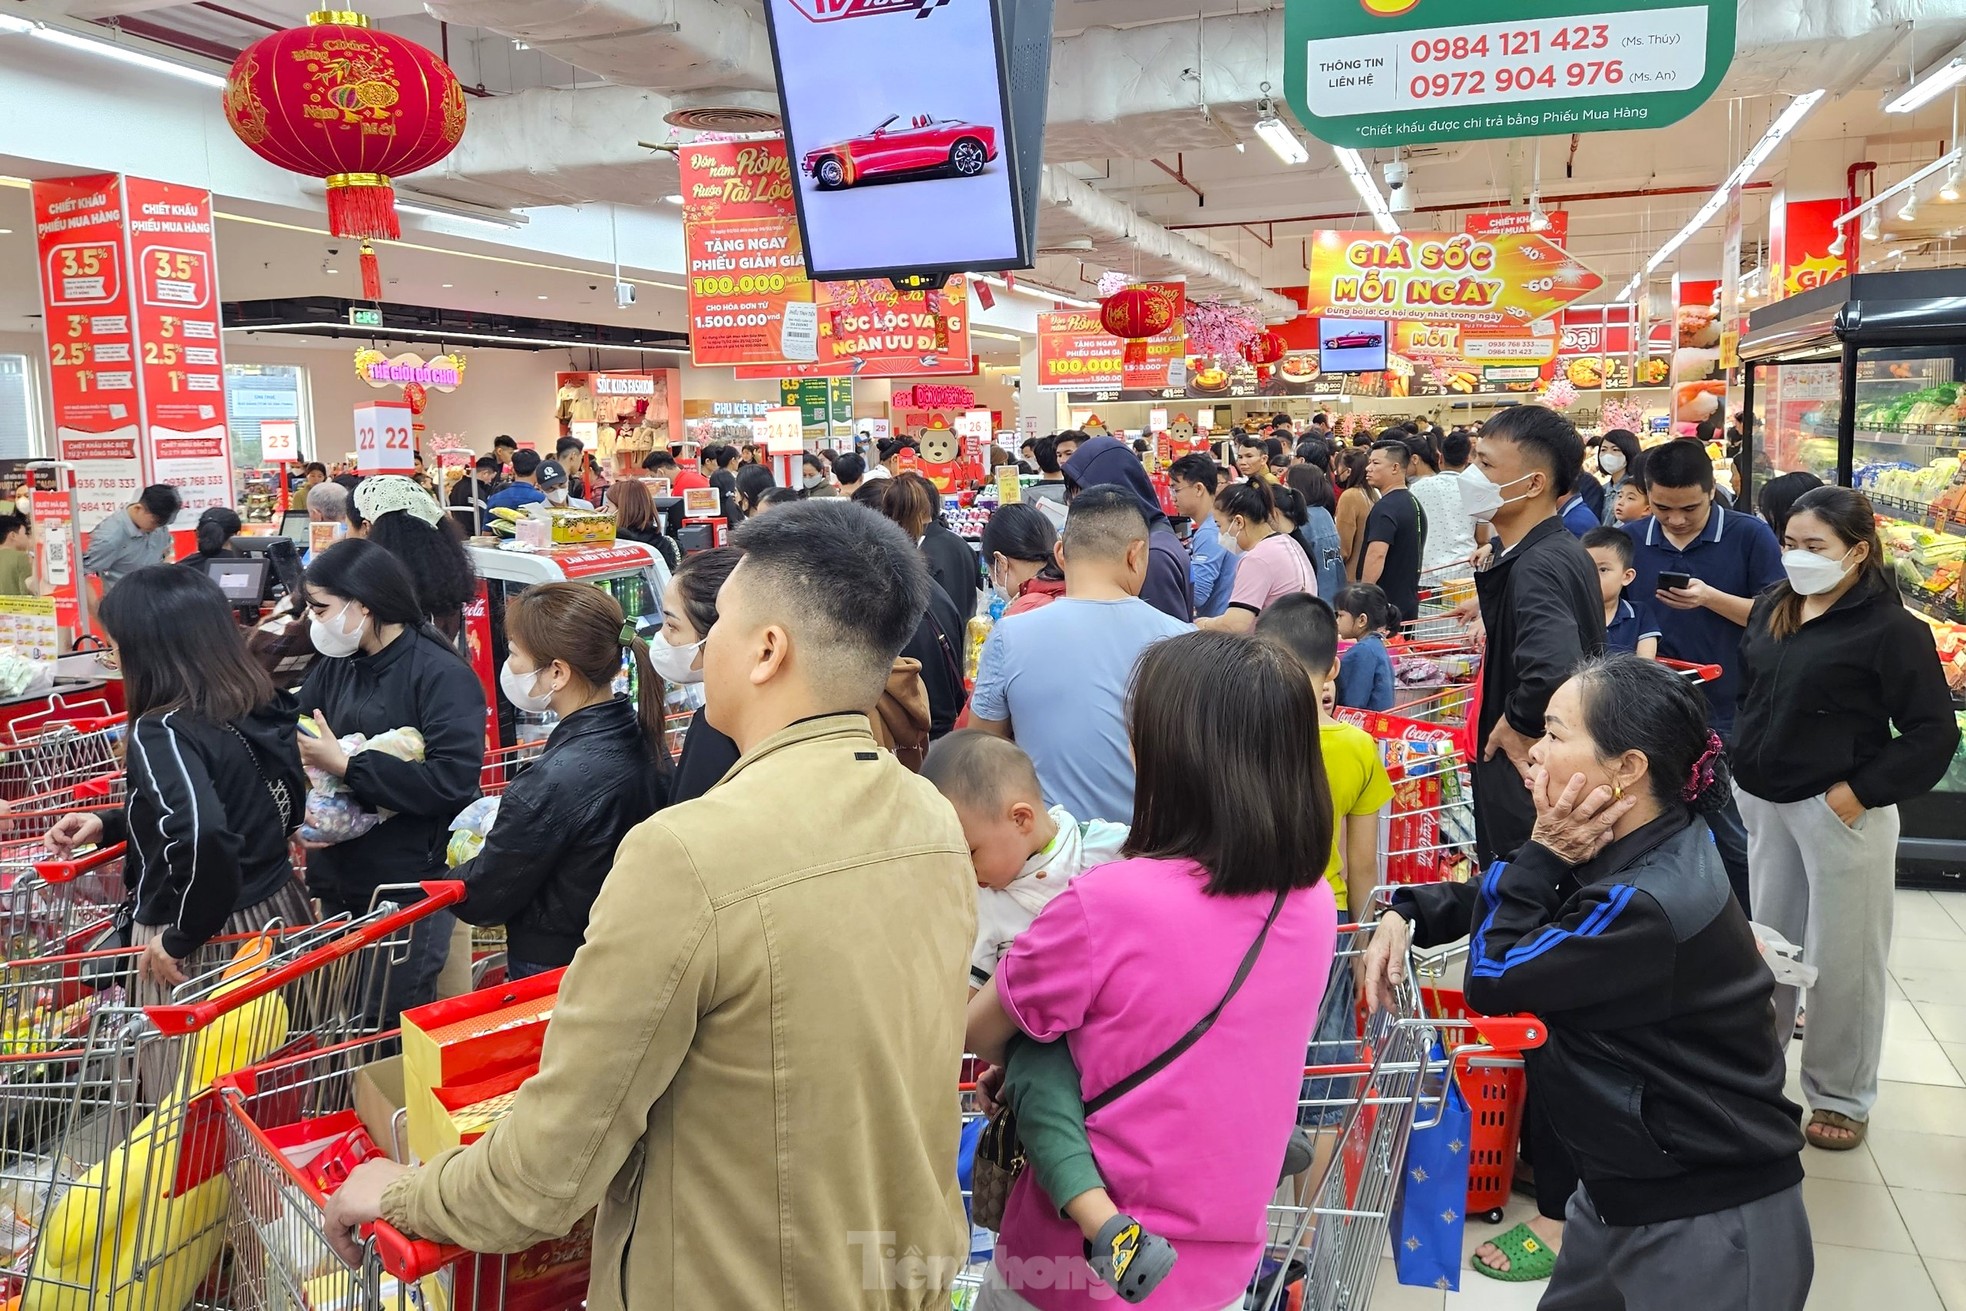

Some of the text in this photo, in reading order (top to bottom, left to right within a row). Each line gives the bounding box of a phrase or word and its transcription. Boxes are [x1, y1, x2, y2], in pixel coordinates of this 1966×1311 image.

[1411, 25, 1682, 64] 0984 121 423 (Ms. Thúy)
[1320, 58, 1384, 72] THÔNG TIN
[1328, 72, 1374, 88] LIÊN HỆ
[1410, 60, 1677, 99] 0972 904 976 (Ms. An)
[1396, 121, 1426, 134] khấu
[1428, 118, 1461, 132] được
[1464, 117, 1482, 129] chi
[1485, 114, 1504, 127] trả
[1507, 112, 1539, 128] bằng
[1543, 109, 1580, 124] Phiếu
[1583, 109, 1610, 121] Mua
[1614, 105, 1649, 120] Hàng
[691, 154, 717, 170] Đón
[709, 146, 791, 180] năm Rồng
[723, 178, 752, 203] Tài
[753, 176, 793, 206] Lộc
[49, 191, 107, 215] CHIẾT KHẤU
[142, 201, 198, 216] CHIẾT KHẤU
[38, 209, 121, 234] PHIẾU MUA HÀNG
[132, 218, 211, 234] PHIẾU MUA HÀNG
[1490, 216, 1516, 228] CHIẾT
[1506, 226, 1526, 235] MUA
[704, 237, 788, 253] TẶNG NGAY
[1349, 235, 1492, 270] GIÁ SỐC
[61, 248, 108, 276] 3.5%
[154, 252, 199, 280] 3.5%
[693, 252, 805, 272] PHIẾU GIẢM GIÁ
[693, 273, 785, 296] 100.000
[1335, 270, 1501, 304] MỖI NGÀY
[1521, 276, 1563, 293] -60%
[706, 301, 769, 312] CHO HÓA ĐƠN TỪ
[1327, 307, 1502, 321] Đừng bỏ lỡ! Cơ hội duy nhất trong ngày
[695, 313, 767, 329] 1.500.000
[874, 311, 910, 333] LỘC
[1068, 314, 1103, 336] Rồng
[832, 335, 883, 357] NGÀN
[886, 335, 914, 350] ƯU
[1074, 340, 1117, 348] TẶNG NGAY
[1413, 329, 1449, 347] MỖI
[1066, 348, 1089, 357] PHIẾU
[1090, 347, 1112, 357] GIẢM
[368, 360, 460, 385] THẾ GIỚI ĐỒ CHƠI
[597, 375, 654, 394] SỐC KIDS FASHION
[714, 400, 753, 418] PHỤ KIỆN
[769, 424, 800, 438] 24 24
[876, 424, 887, 433] 29
[970, 422, 982, 432] 26
[269, 435, 291, 448] 23
[360, 428, 409, 450] 22 22
[76, 479, 136, 489] 936 768 333
[189, 476, 205, 486] 768
[208, 476, 223, 485] 333
[102, 502, 115, 511] 121
